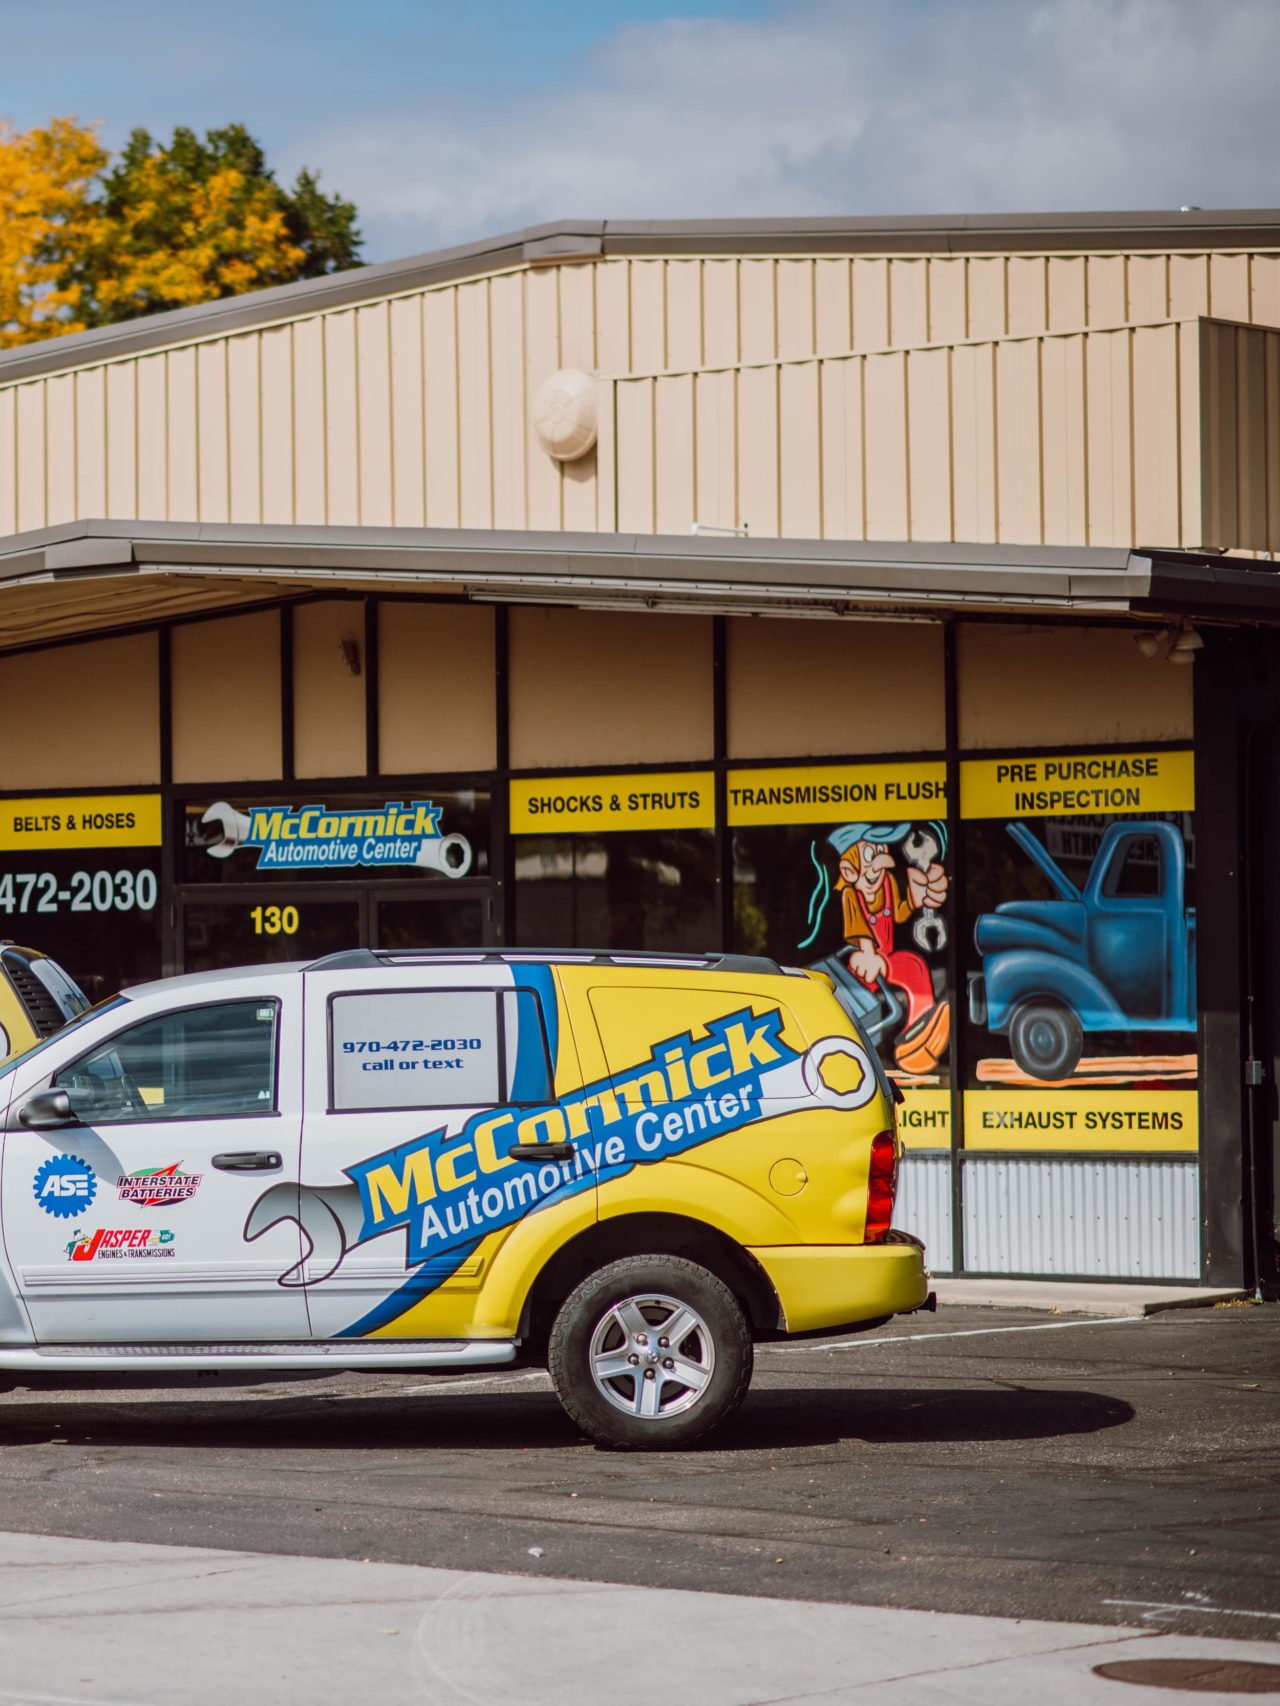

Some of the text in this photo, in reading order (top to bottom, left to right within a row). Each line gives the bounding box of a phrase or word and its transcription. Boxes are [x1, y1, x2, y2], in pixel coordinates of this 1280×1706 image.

[996, 758, 1159, 784] PRE PURCHASE
[528, 791, 700, 814] SHOCKS & STRUTS
[730, 781, 947, 807] TRANSMISSION FLUSH
[1014, 788, 1141, 811] INSPECTION
[13, 812, 136, 832] BELTS & HOSES
[251, 807, 437, 840] McCormick
[264, 838, 418, 862] Automotive Center
[250, 905, 299, 935] 130
[343, 1038, 481, 1053] 970-472-2030
[362, 1058, 464, 1071] call or text
[365, 1022, 782, 1224] McCormick
[899, 1110, 949, 1128] IGHT
[982, 1111, 1184, 1130] EXHAUST SYSTEMS
[421, 1084, 753, 1248] Automotive Center
[41, 1174, 89, 1197] ASE
[119, 1176, 200, 1187] INTERSTATE
[121, 1187, 194, 1198] BATTERIES
[72, 1228, 152, 1261] JASPER
[98, 1249, 123, 1259] ENGINES
[127, 1248, 175, 1259] TRANSMISSIONS
